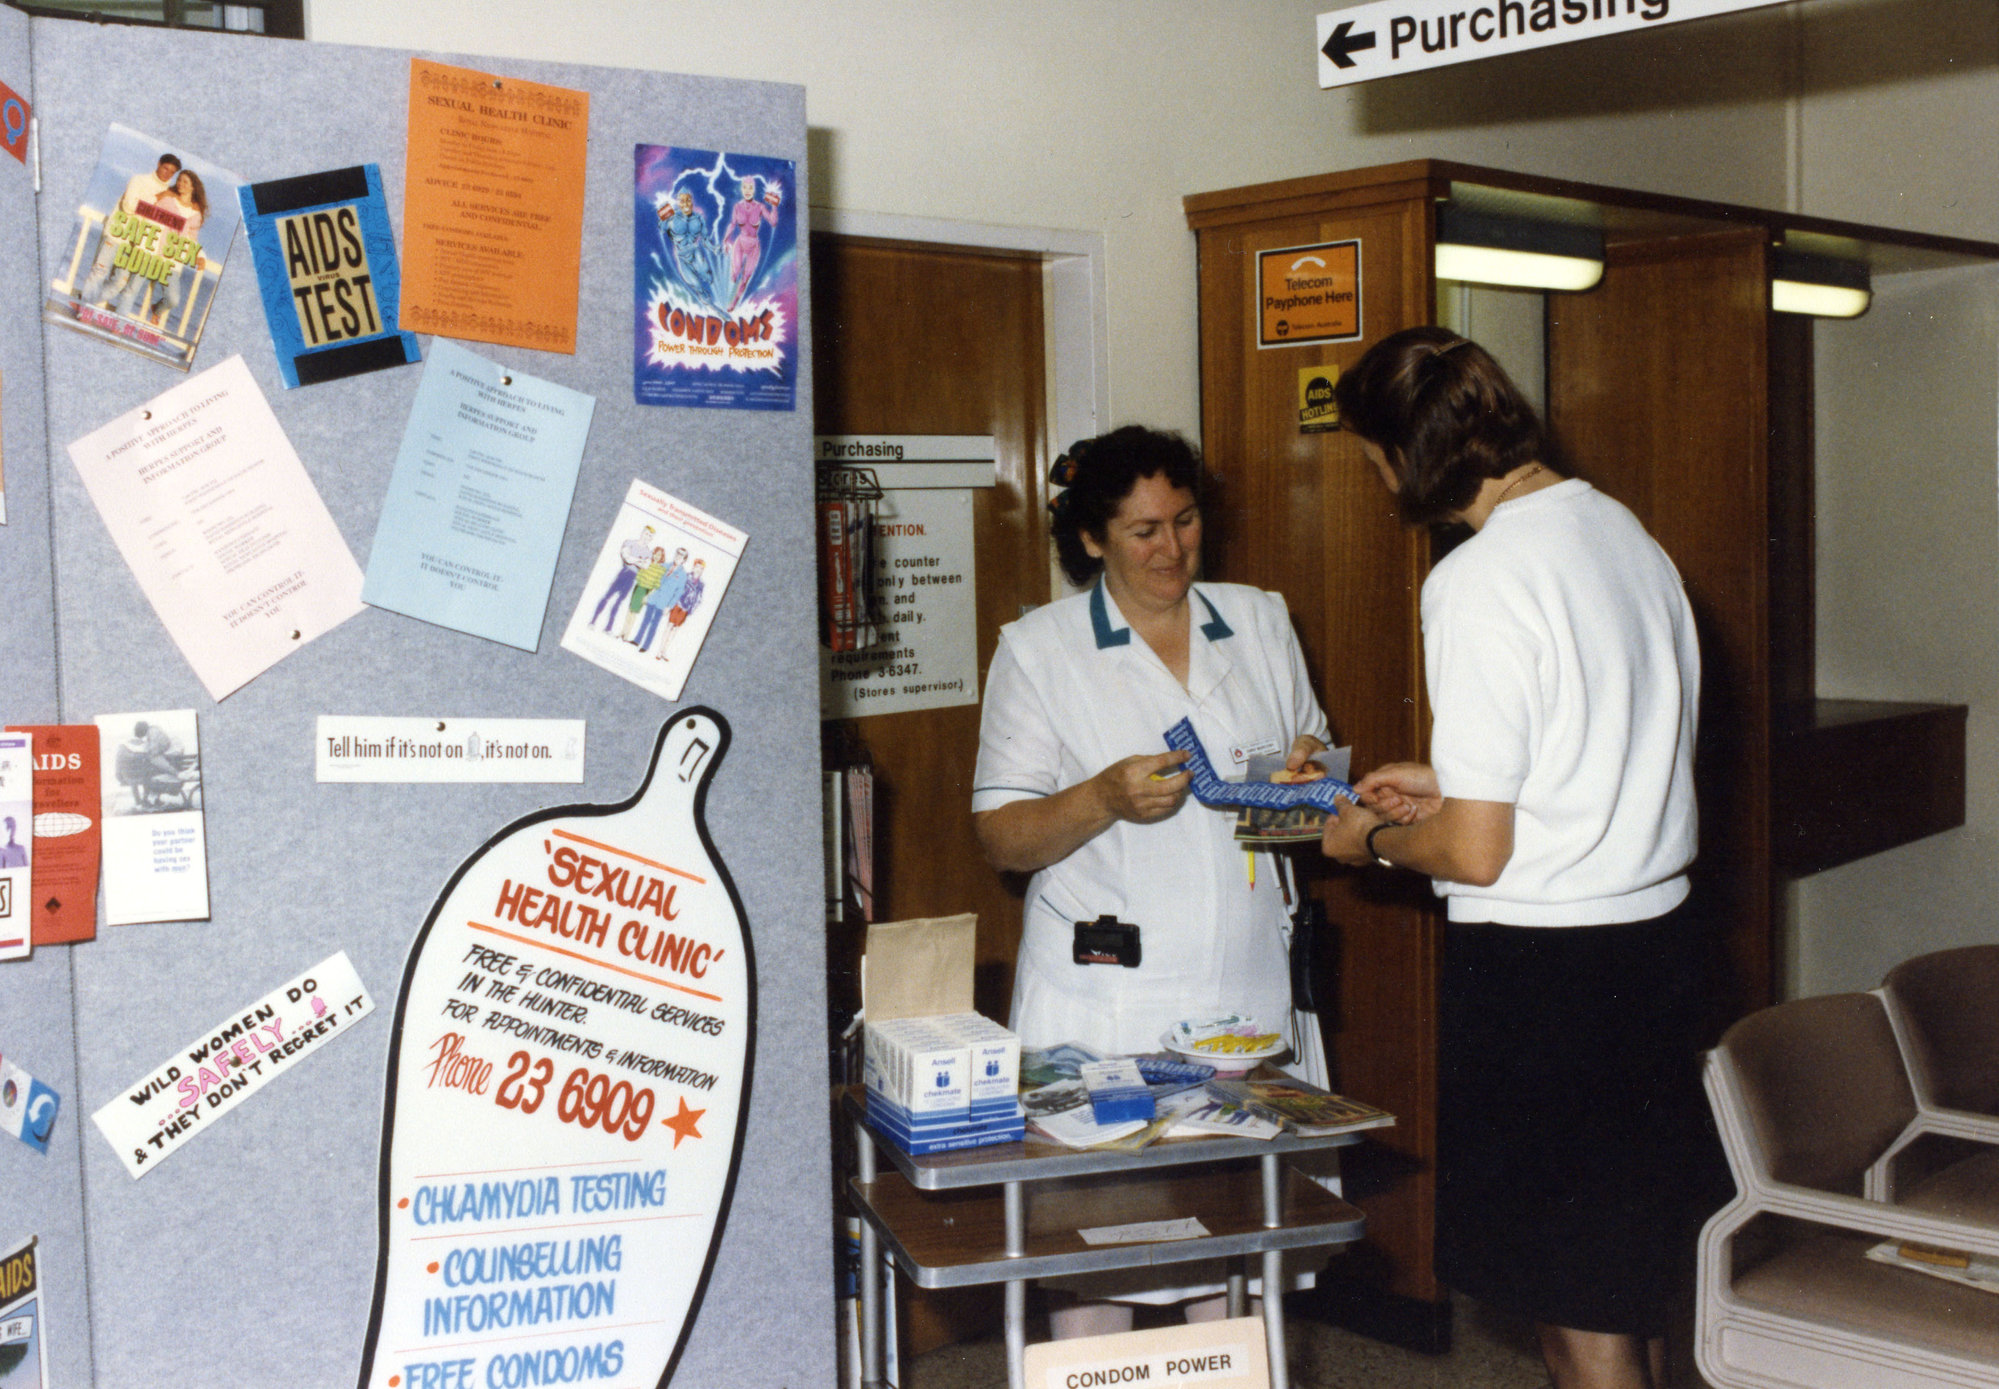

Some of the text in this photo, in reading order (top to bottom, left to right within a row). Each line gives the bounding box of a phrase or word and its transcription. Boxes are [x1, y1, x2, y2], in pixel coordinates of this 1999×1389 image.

[428, 95, 475, 112] SEXUAL
[480, 105, 527, 122] HEALTH
[533, 114, 572, 130] CLINIC
[110, 210, 202, 268] SAFE SEX
[285, 207, 363, 279] AIDS
[114, 242, 175, 287] GUIDE
[317, 272, 341, 281] VIRUS
[1285, 277, 1333, 291] Telecom
[294, 274, 377, 344] TEST
[1266, 290, 1353, 311] Payphone Here
[658, 302, 774, 347] CONDOMS
[1308, 388, 1331, 400] AIDS
[822, 441, 904, 460] Purchasing
[640, 489, 668, 511] Sexually
[709, 520, 737, 542] Diseases
[895, 557, 940, 569] counter
[877, 573, 962, 589] only between
[894, 592, 915, 604] and
[893, 611, 926, 623] daily.
[831, 646, 914, 664] requirements
[831, 669, 870, 682] Phone
[854, 687, 895, 701] (Stores
[328, 736, 350, 757] Tell
[354, 736, 381, 758] him
[386, 736, 395, 758] if
[399, 738, 416, 758] it's
[420, 741, 442, 758] not
[446, 744, 463, 758] on
[506, 742, 528, 759] not
[532, 744, 552, 759] on.
[33, 799, 80, 808] ravellers
[495, 878, 612, 948] HEALTH
[457, 971, 485, 993] IN
[485, 979, 517, 1002] THE
[462, 944, 725, 1037] FREE & CONFIDENTIAL SERVICES
[130, 978, 317, 1106] WILD WOMEN DO
[441, 999, 479, 1023] FOR
[482, 1010, 604, 1060] APPOINTMENTS
[617, 1050, 719, 1091] INFORMATION
[982, 1047, 1006, 1055] Ansell
[931, 1058, 956, 1066] Ansell
[134, 994, 364, 1165] & THEY DON'T REGRET IT
[423, 1032, 655, 1142] Phone 23 6909
[924, 1088, 962, 1097] chekmate
[974, 1076, 1010, 1086] chekmate
[929, 1141, 946, 1150] extra
[948, 1139, 977, 1148] sensitive
[413, 1169, 667, 1226] CHLAMYDIA TESTING
[443, 1234, 622, 1288] COUNSELLING
[423, 1279, 616, 1337] INFORMATION
[404, 1339, 624, 1389] FREE CONDOMS
[1066, 1354, 1232, 1389] CONDOM POWER
